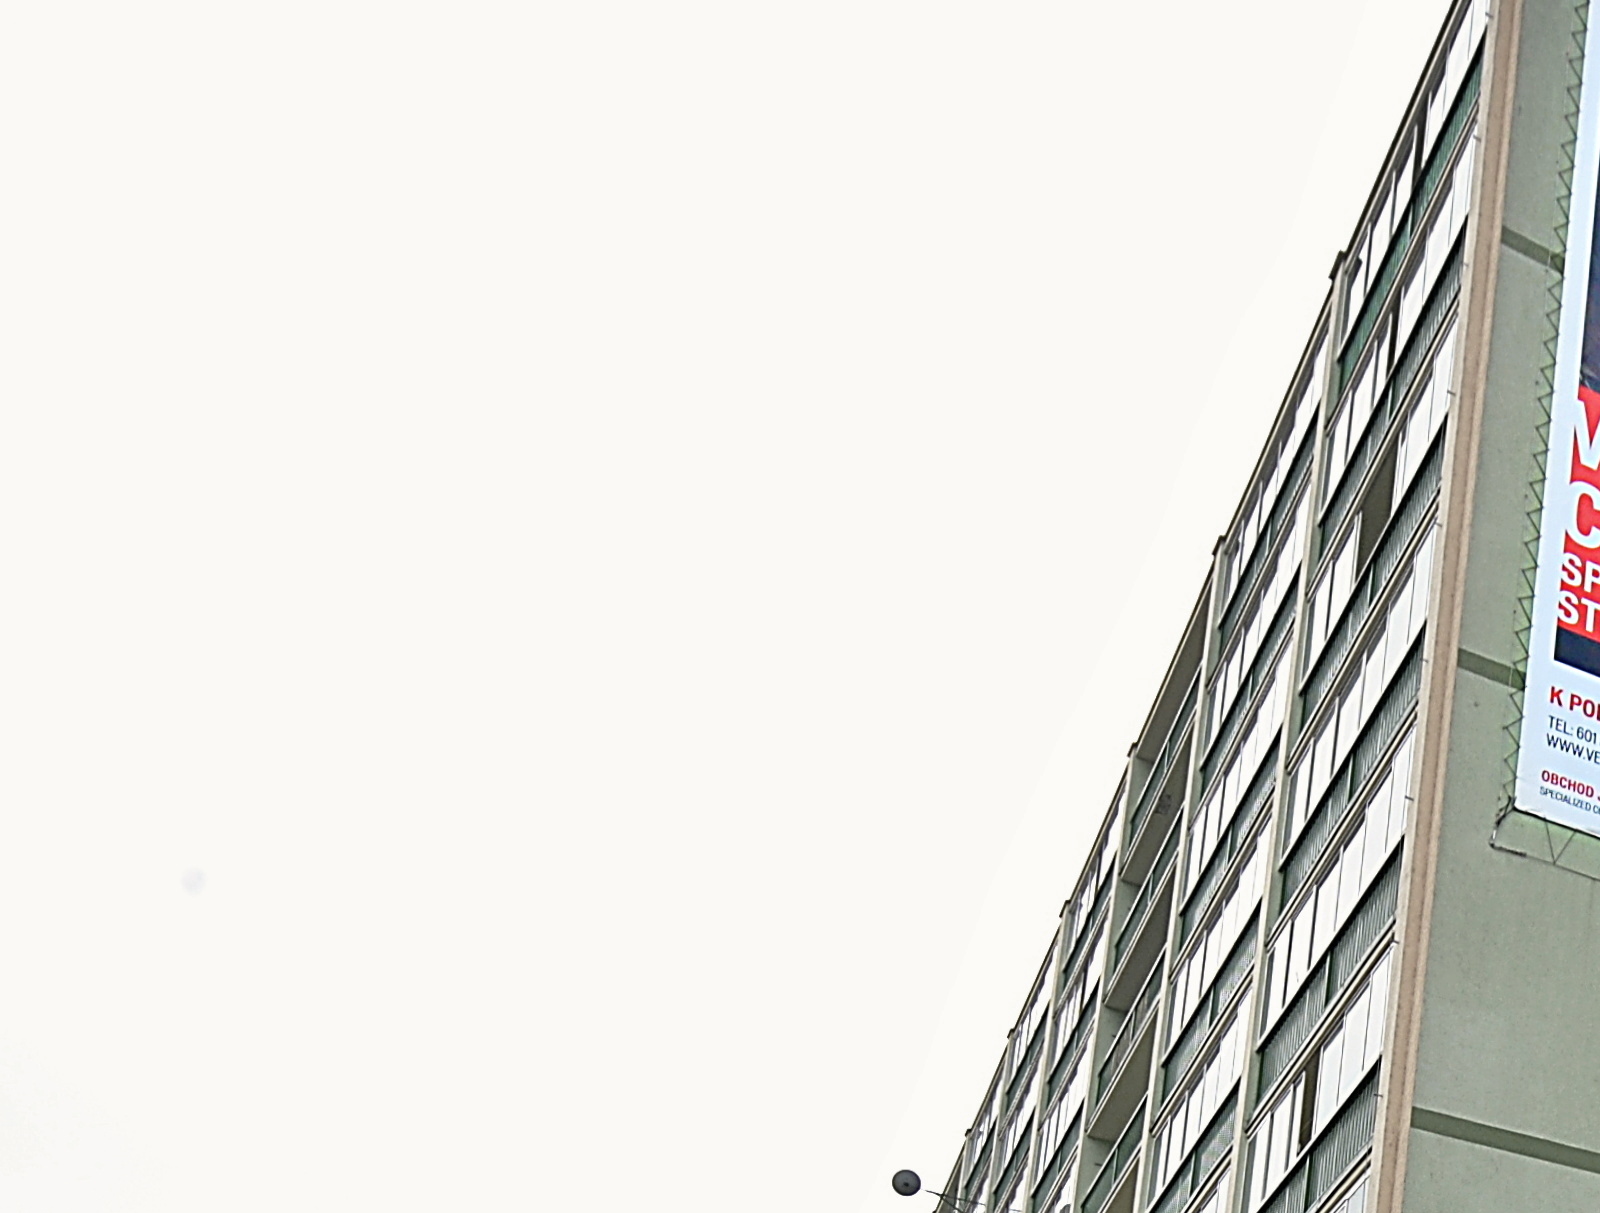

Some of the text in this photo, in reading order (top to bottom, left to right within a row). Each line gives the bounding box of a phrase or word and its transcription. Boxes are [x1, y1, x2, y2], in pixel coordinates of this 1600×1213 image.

[1549, 685, 1564, 707] K
[1548, 714, 1574, 737] TEL:
[1576, 726, 1598, 745] 601
[1541, 769, 1595, 798] OBCHOD
[1539, 786, 1592, 812] SPECIALIZED
